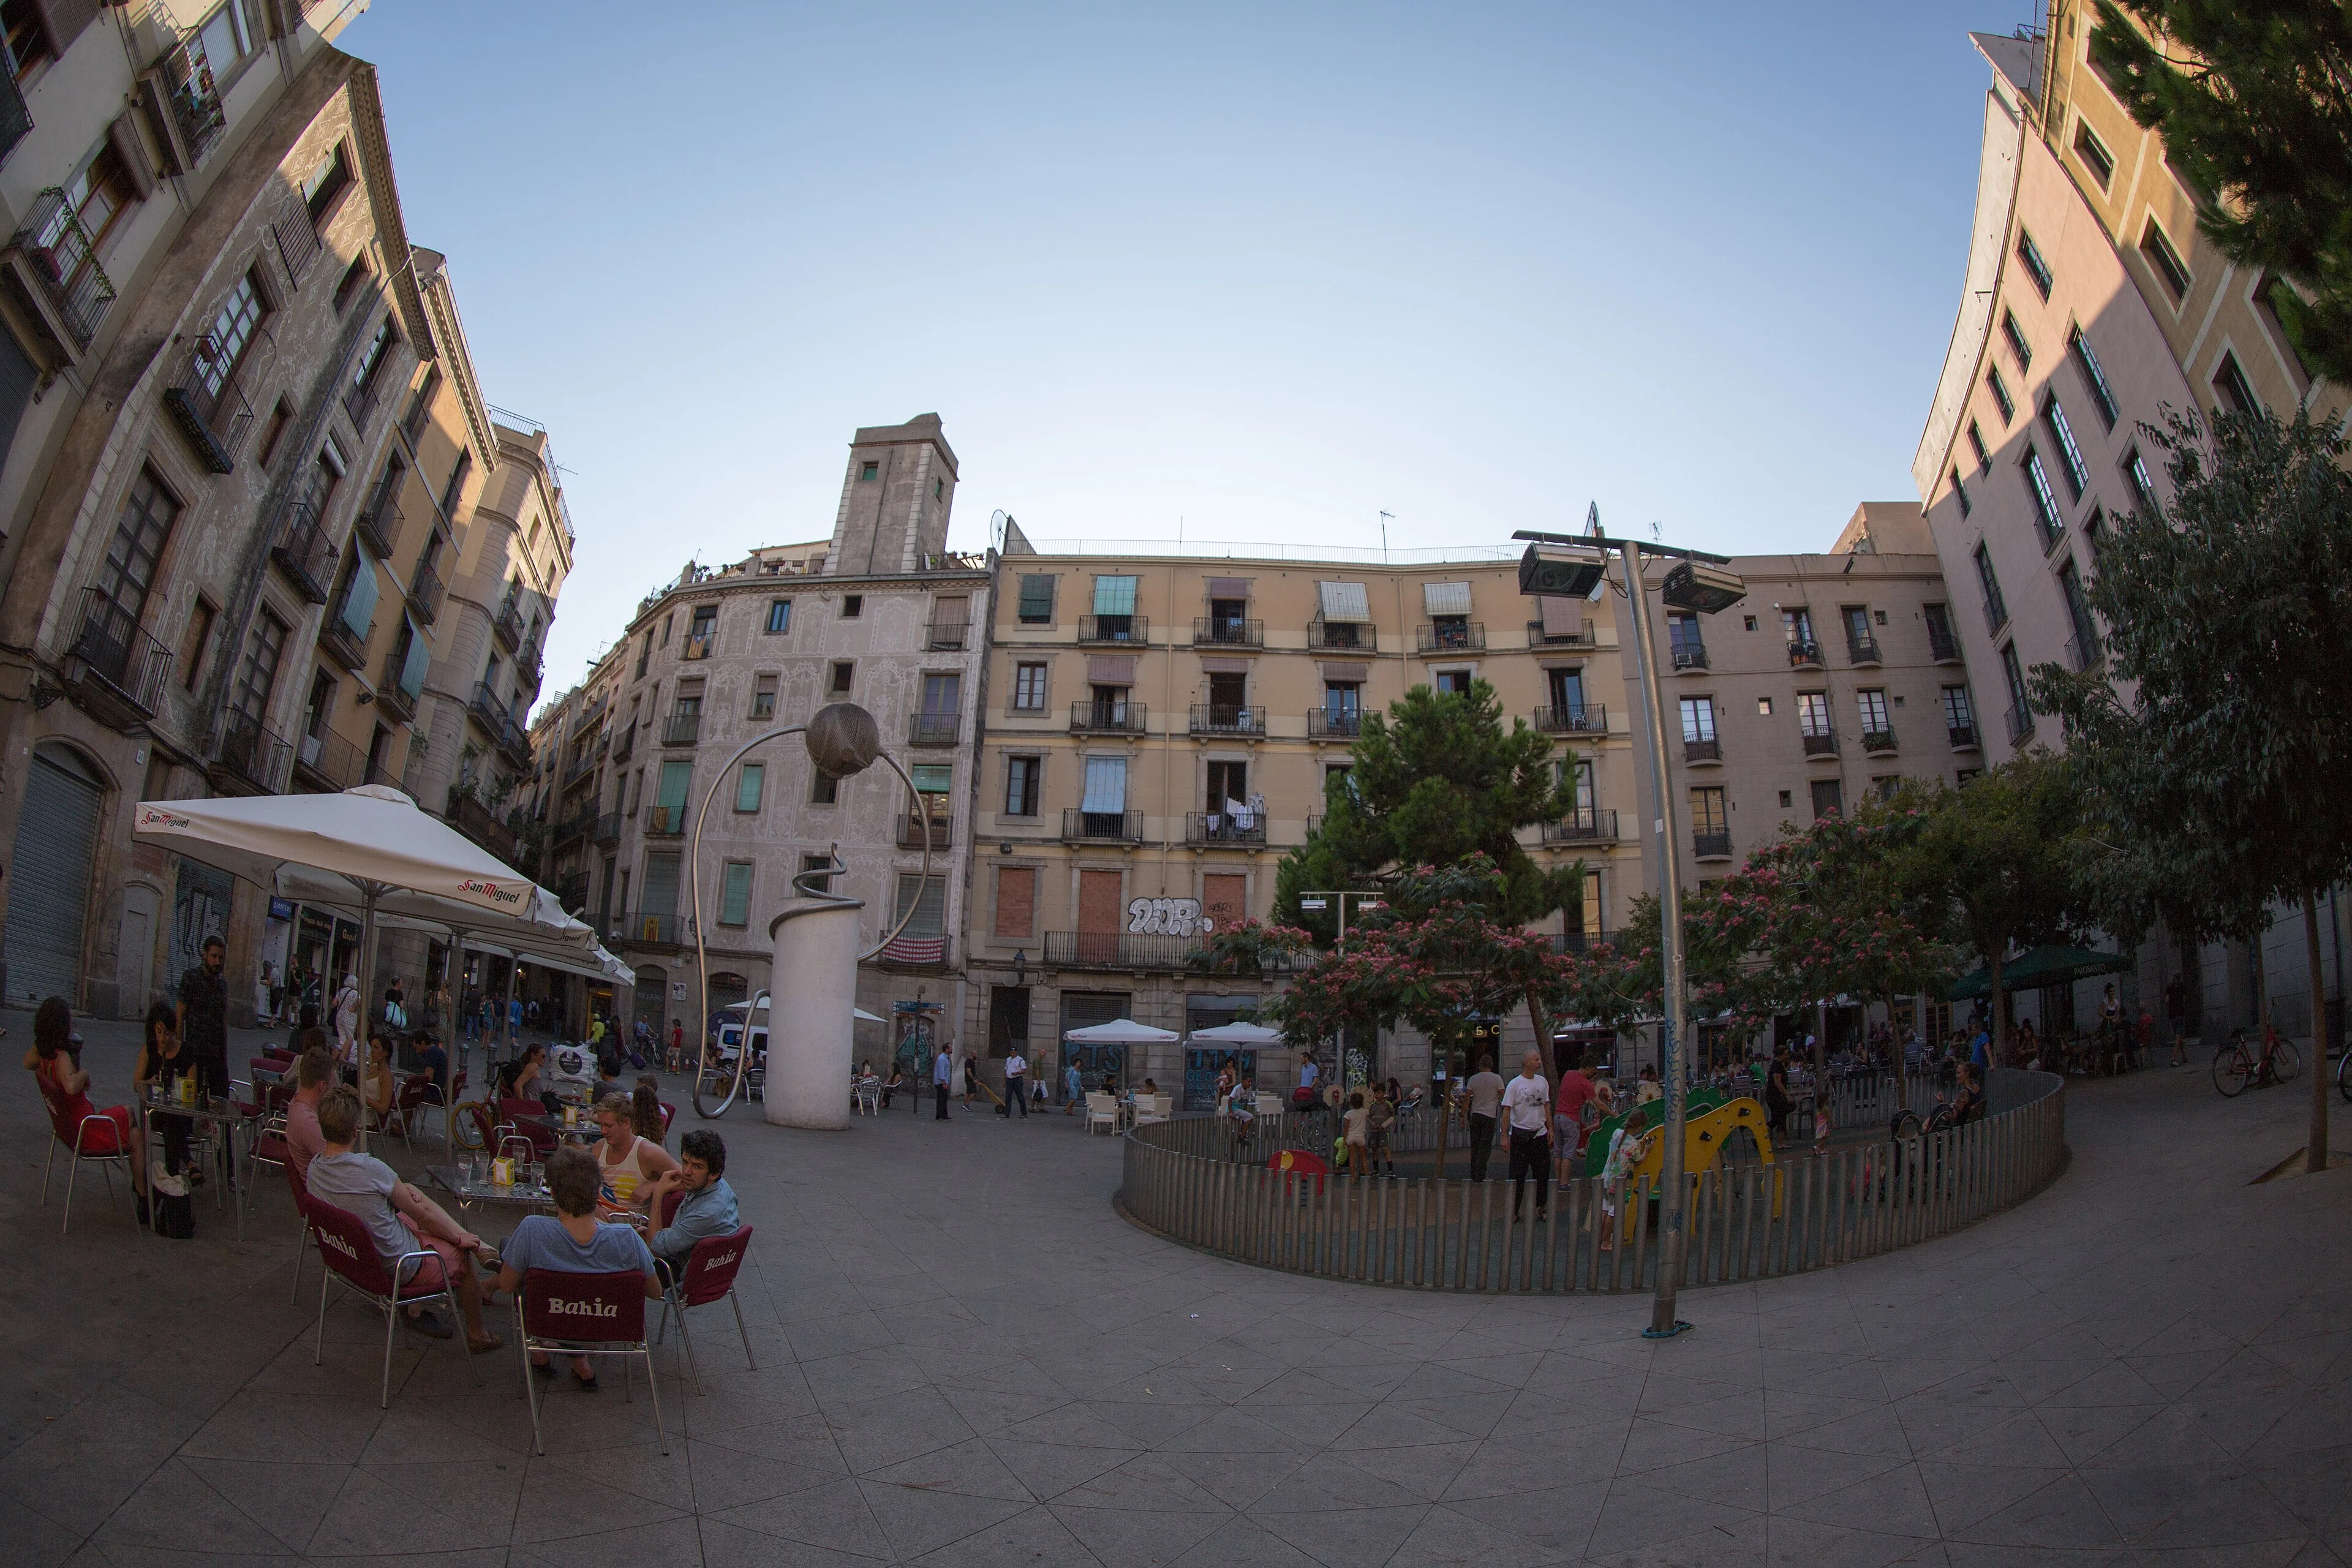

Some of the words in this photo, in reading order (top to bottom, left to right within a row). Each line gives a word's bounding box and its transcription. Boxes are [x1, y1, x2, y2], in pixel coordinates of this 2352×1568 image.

[318, 1226, 358, 1261] Bahia
[704, 1249, 737, 1272] Bahia
[548, 1297, 618, 1317] Bahia
